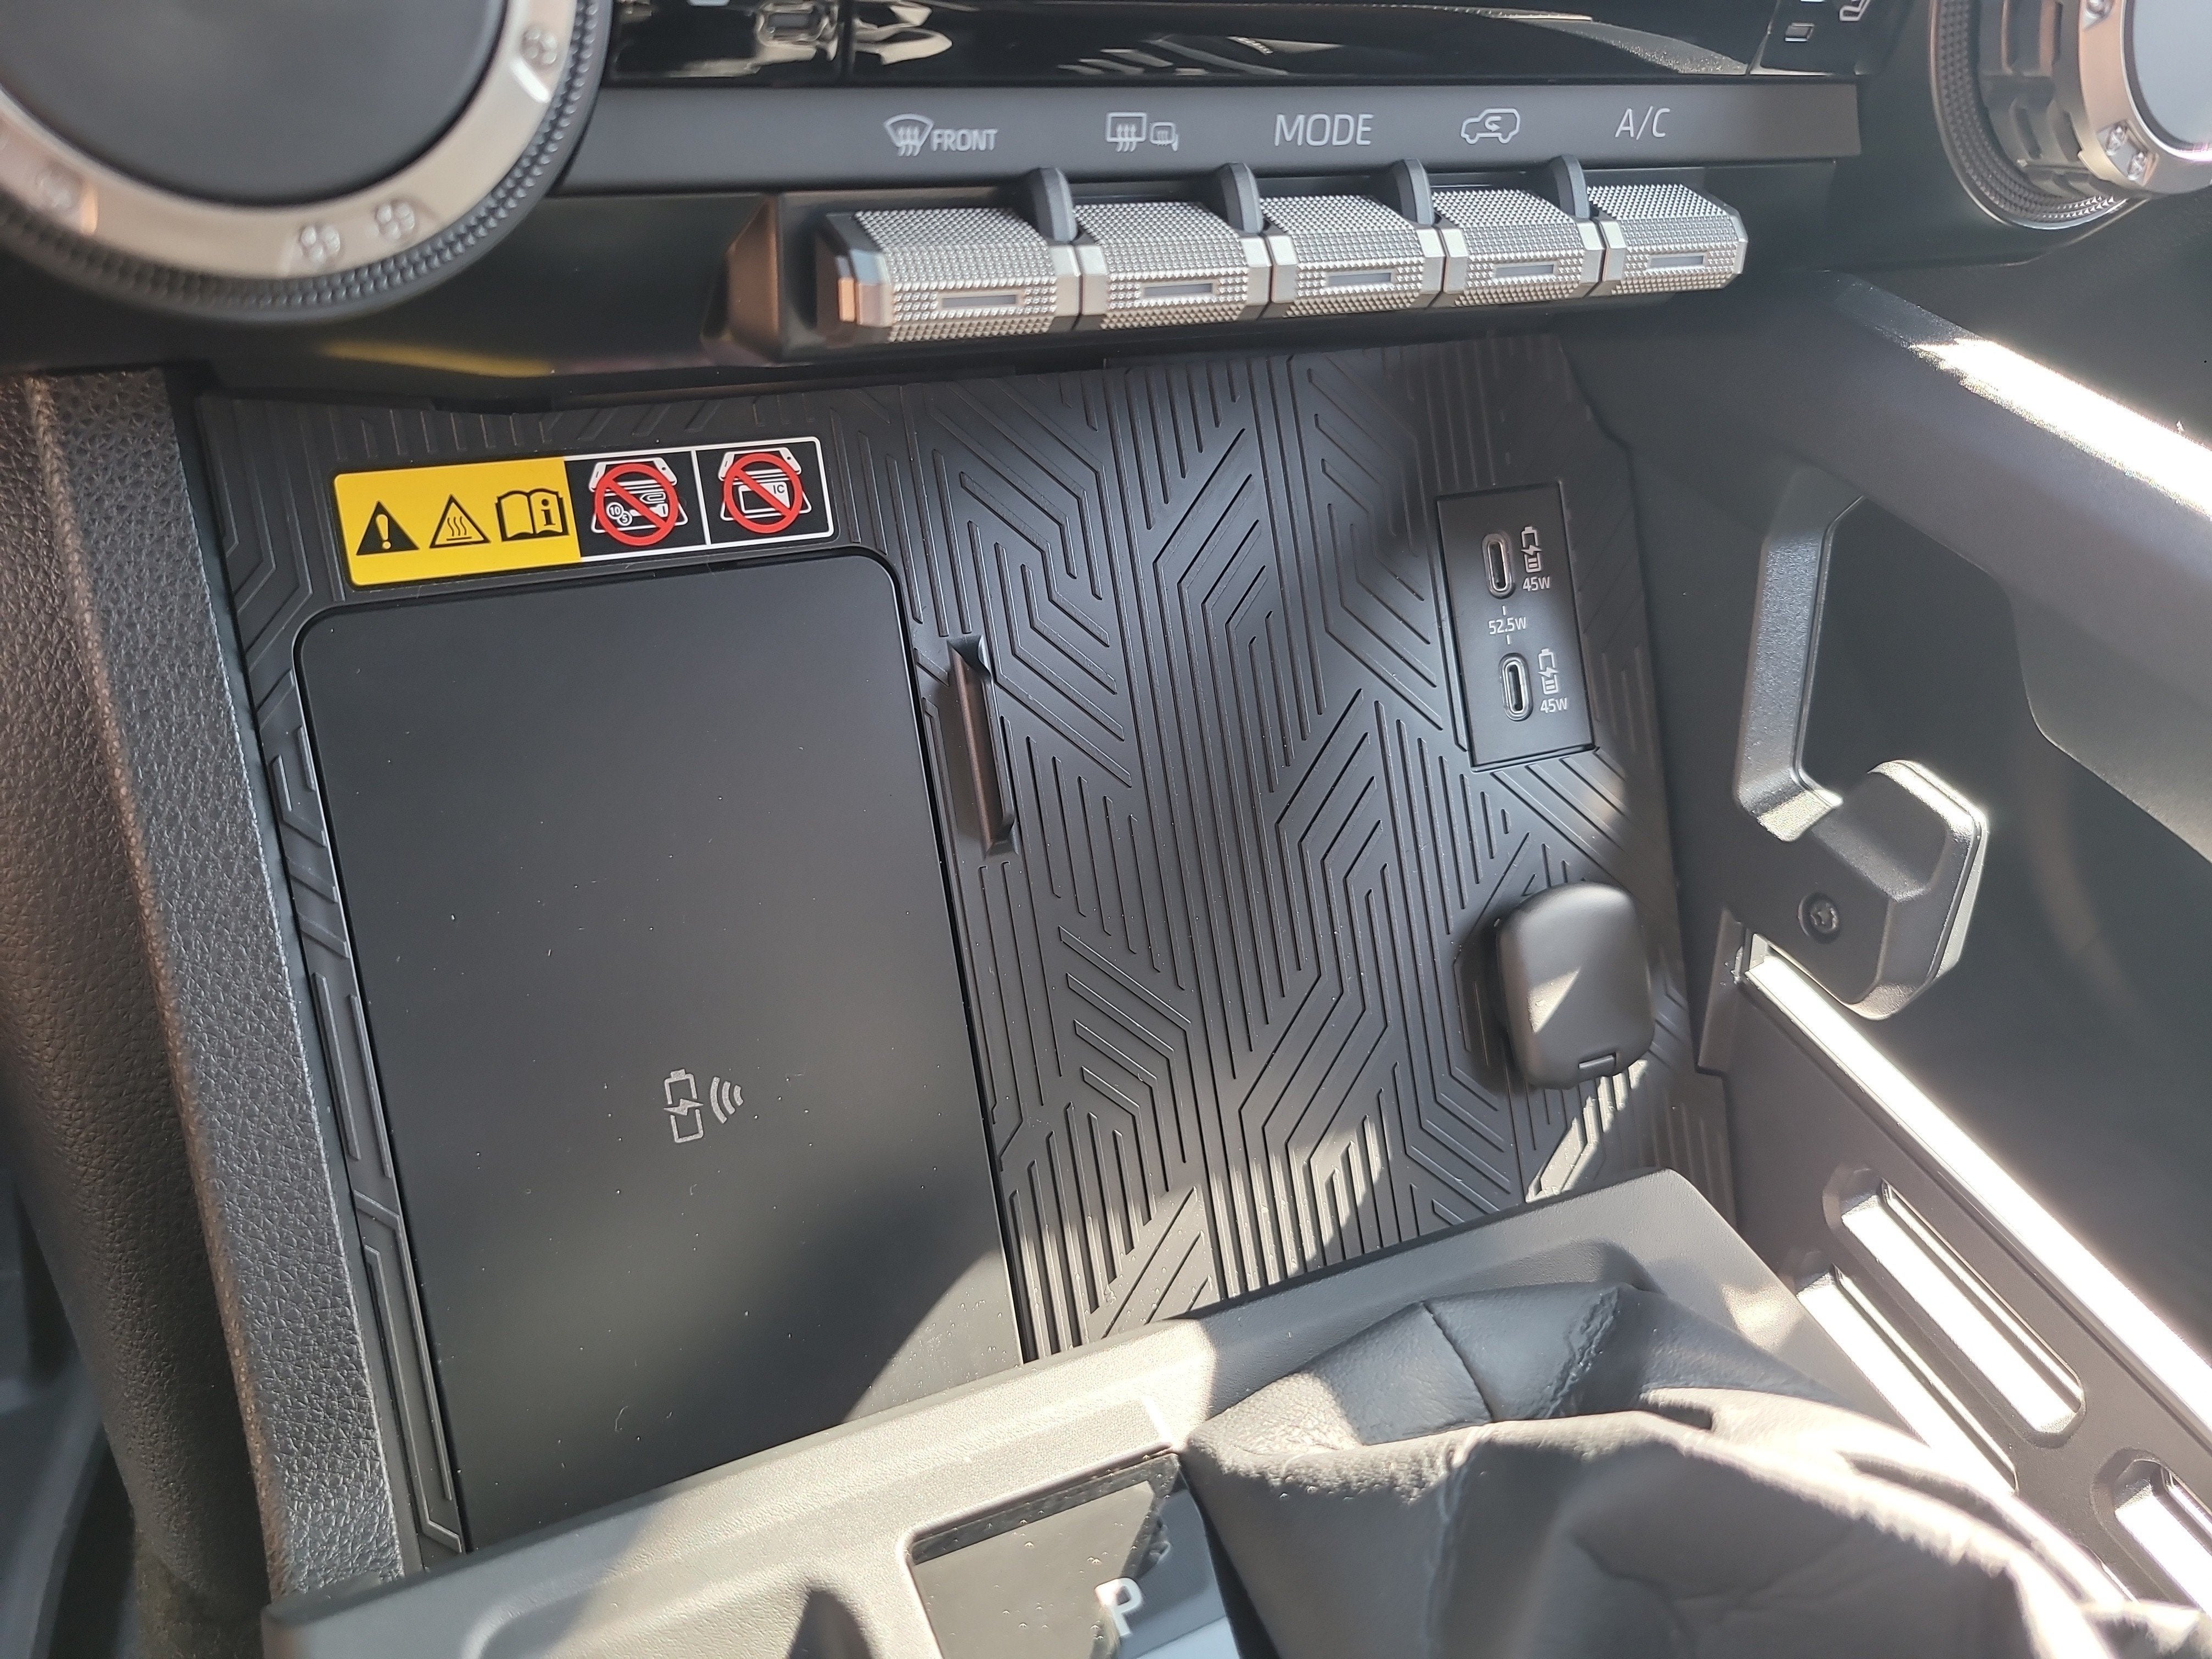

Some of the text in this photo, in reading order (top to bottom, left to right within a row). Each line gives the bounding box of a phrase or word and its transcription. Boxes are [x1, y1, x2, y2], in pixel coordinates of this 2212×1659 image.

[1274, 114, 1374, 146] MODE
[1615, 105, 1671, 140] A/C
[932, 128, 998, 151] FRONT
[772, 484, 786, 495] IC
[610, 506, 621, 516] 10
[622, 514, 628, 523] 5
[1522, 576, 1550, 592] 45W
[1488, 617, 1526, 635] 52.5W
[1540, 697, 1567, 713] 45W
[1095, 1577, 1142, 1637] P
